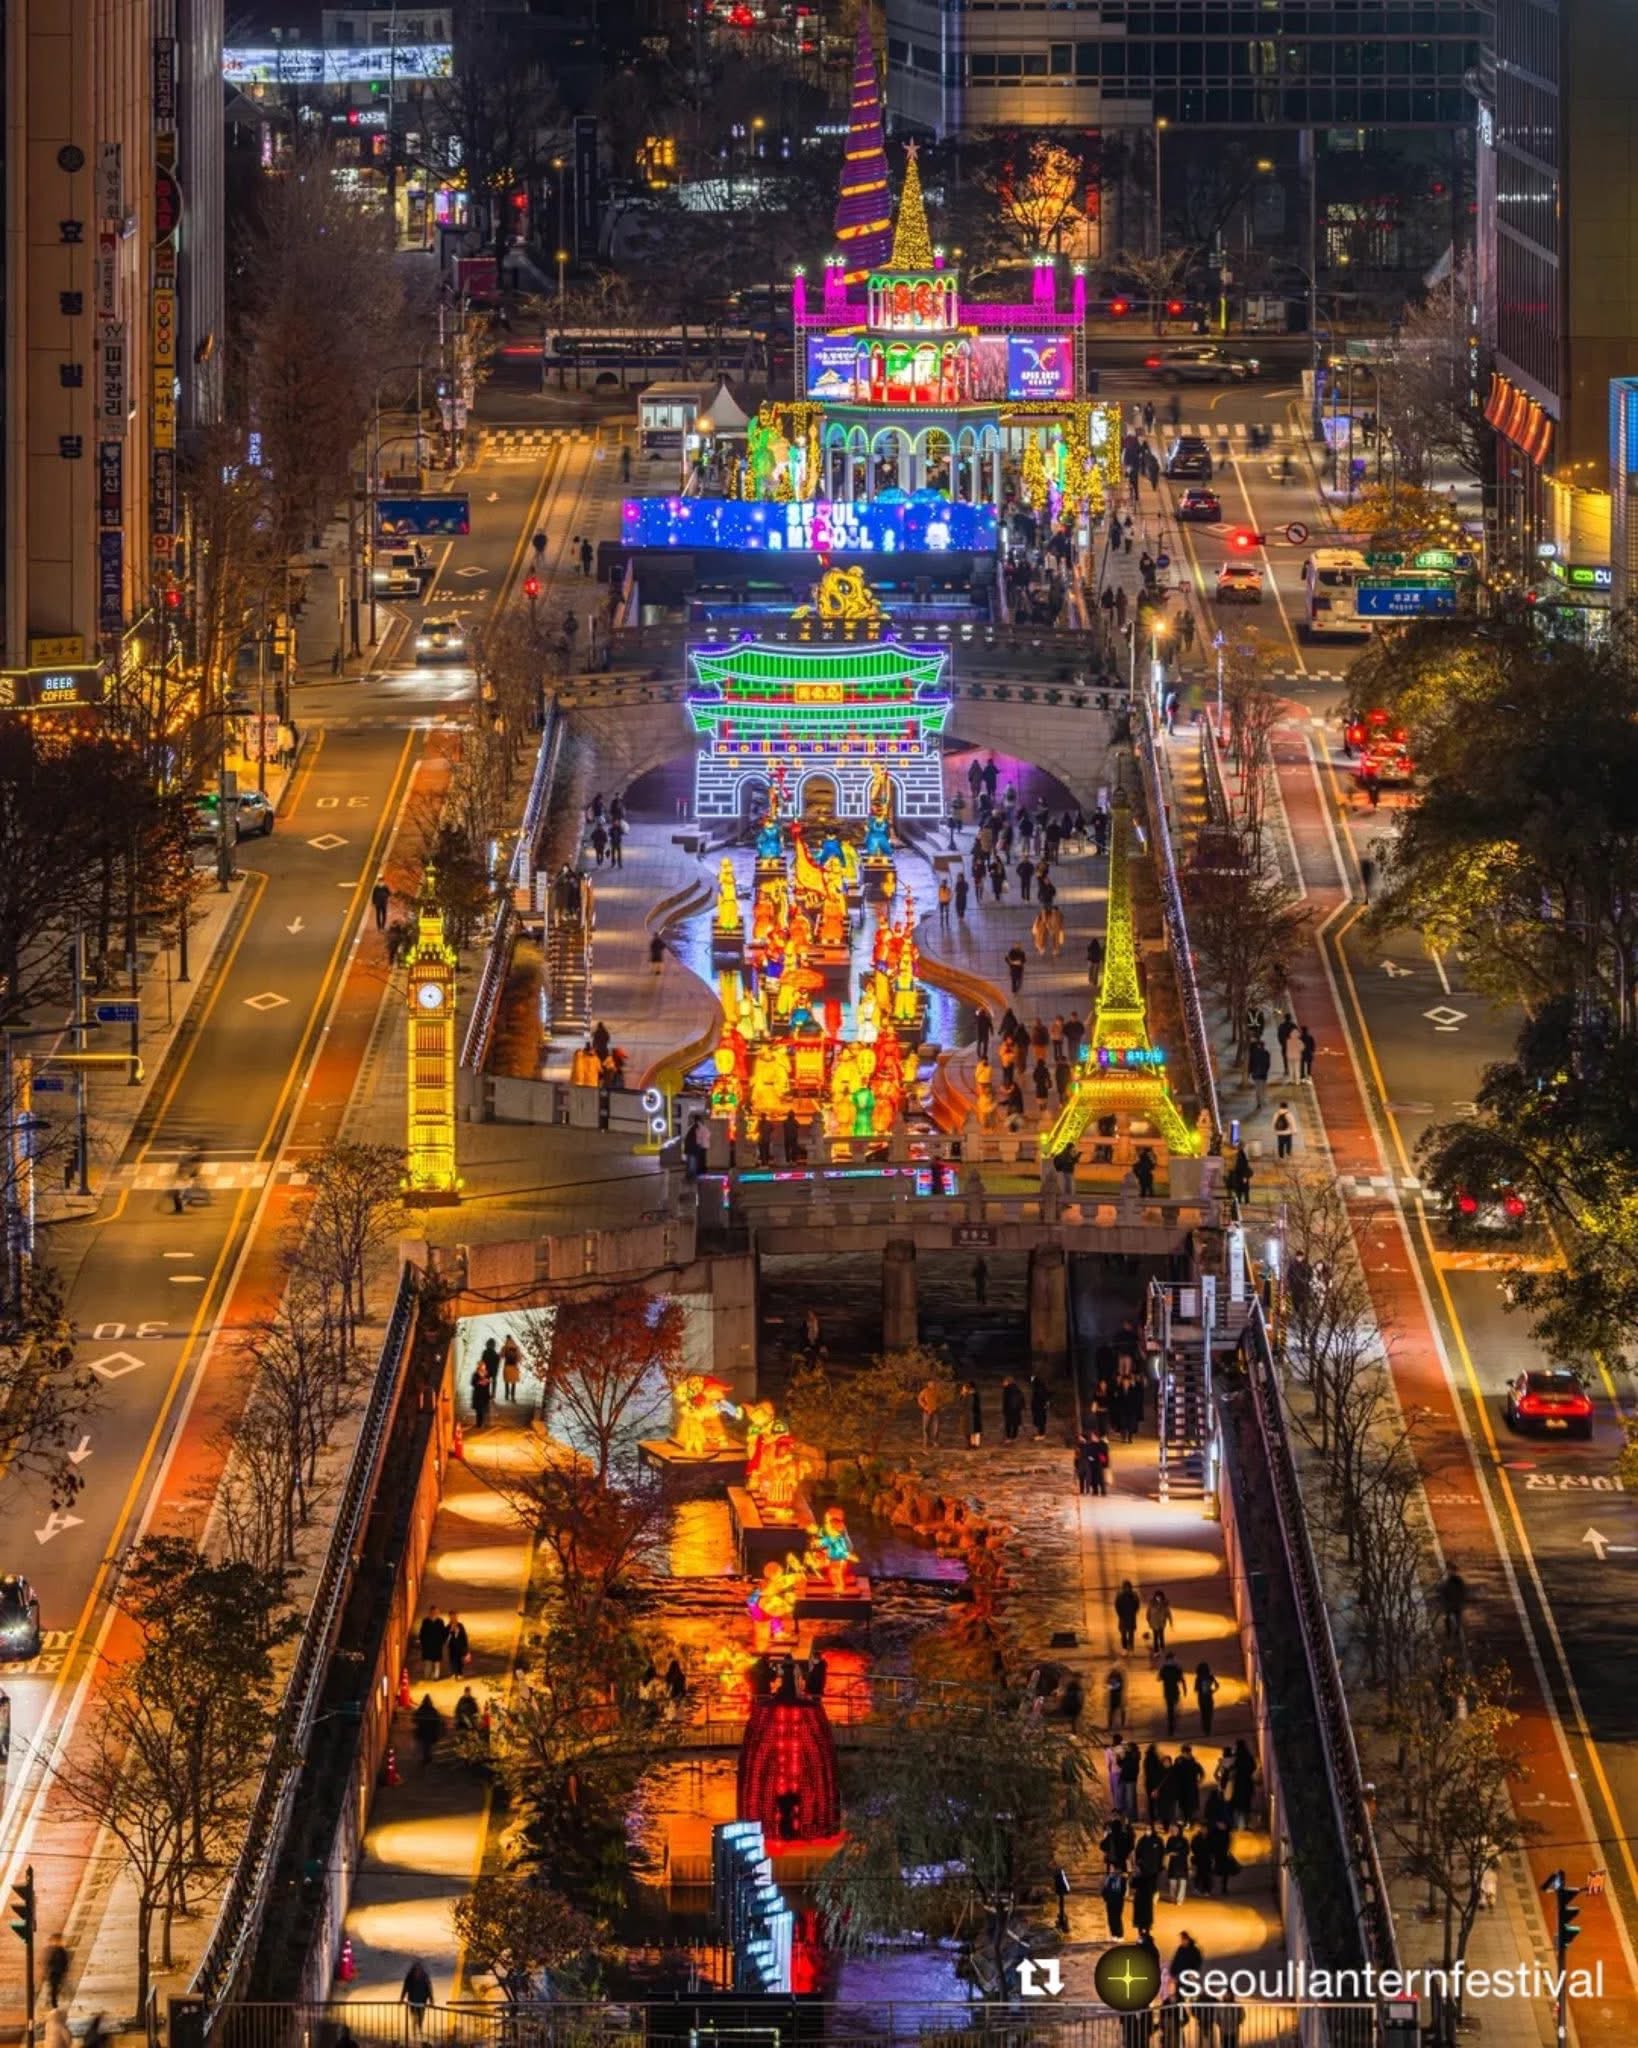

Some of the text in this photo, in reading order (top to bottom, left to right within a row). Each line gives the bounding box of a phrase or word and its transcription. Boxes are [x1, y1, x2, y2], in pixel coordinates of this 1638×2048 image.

[105, 346, 123, 416] 피부관리
[156, 376, 174, 428] 고바우
[155, 535, 176, 558] 약
[1595, 570, 1611, 583] CU
[46, 678, 73, 689] BEER
[41, 689, 77, 701] COFFEE
[93, 1321, 168, 1340] 30
